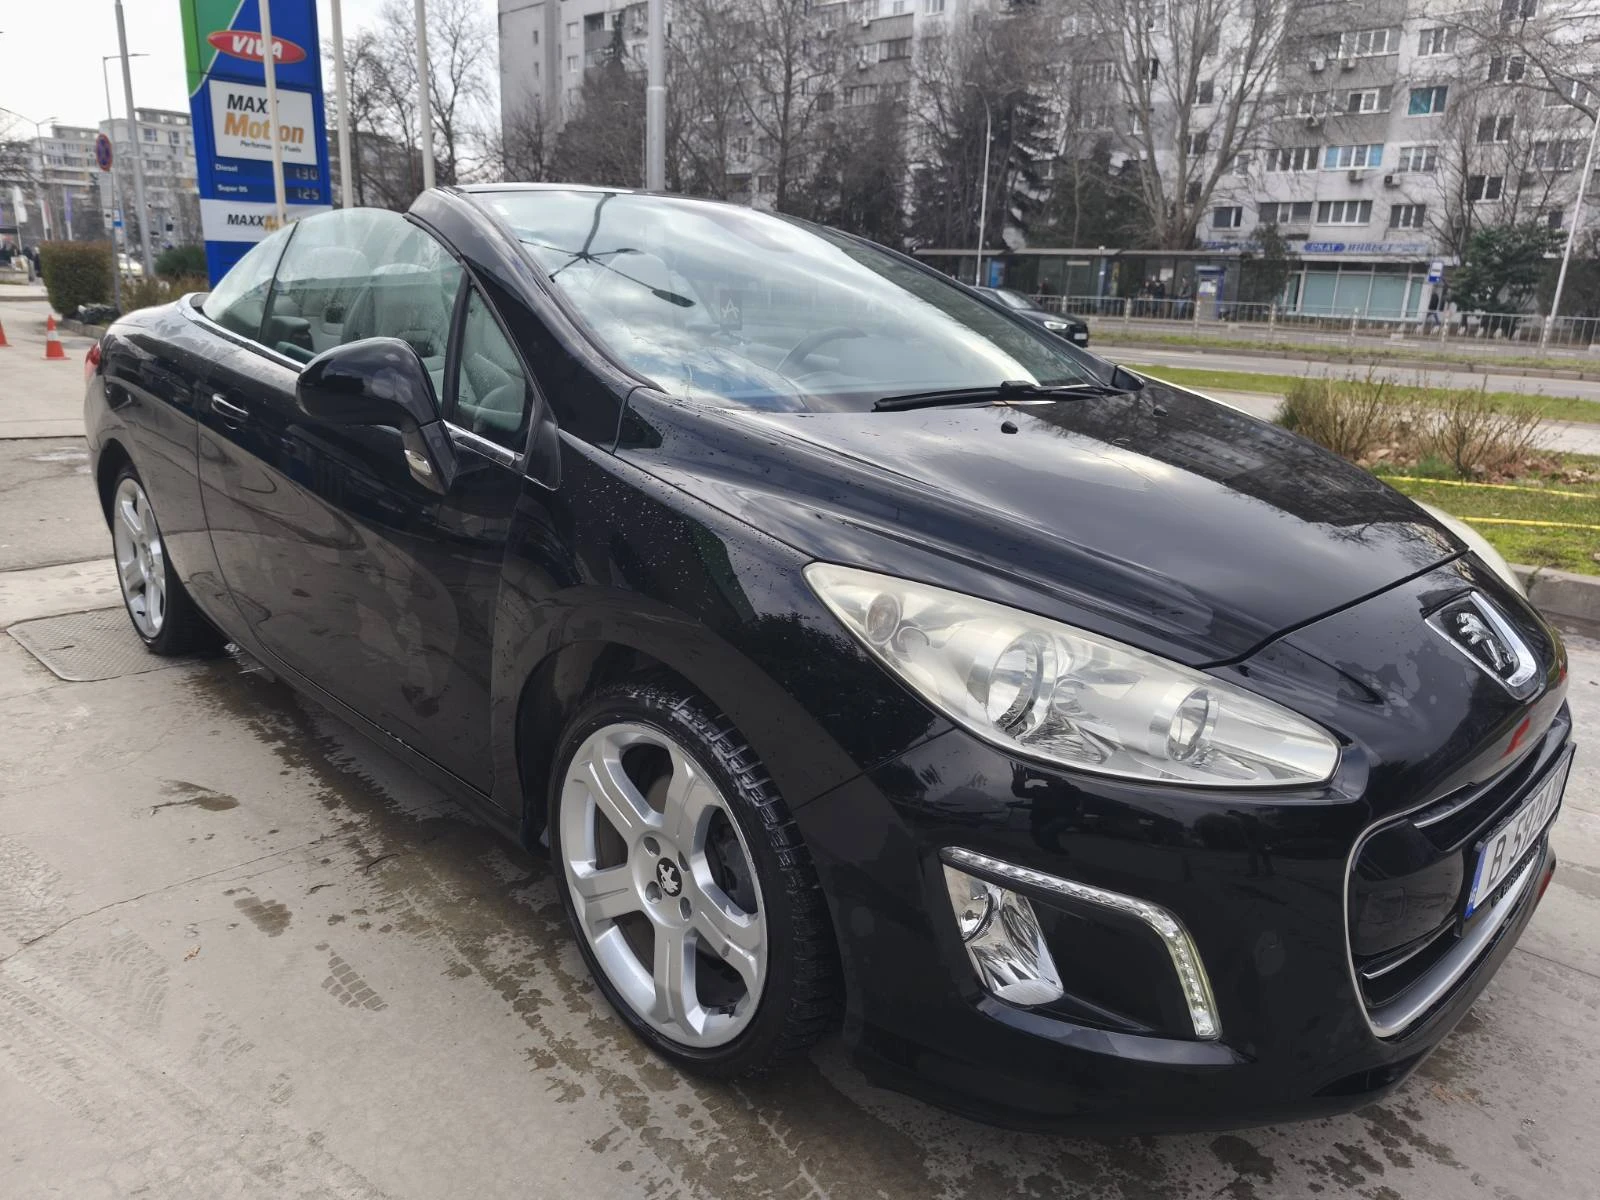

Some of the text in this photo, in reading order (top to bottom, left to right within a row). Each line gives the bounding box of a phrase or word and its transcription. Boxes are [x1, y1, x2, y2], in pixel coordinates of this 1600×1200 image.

[232, 35, 283, 60] VIVA
[227, 94, 279, 114] MAX
[224, 112, 304, 144] Moton
